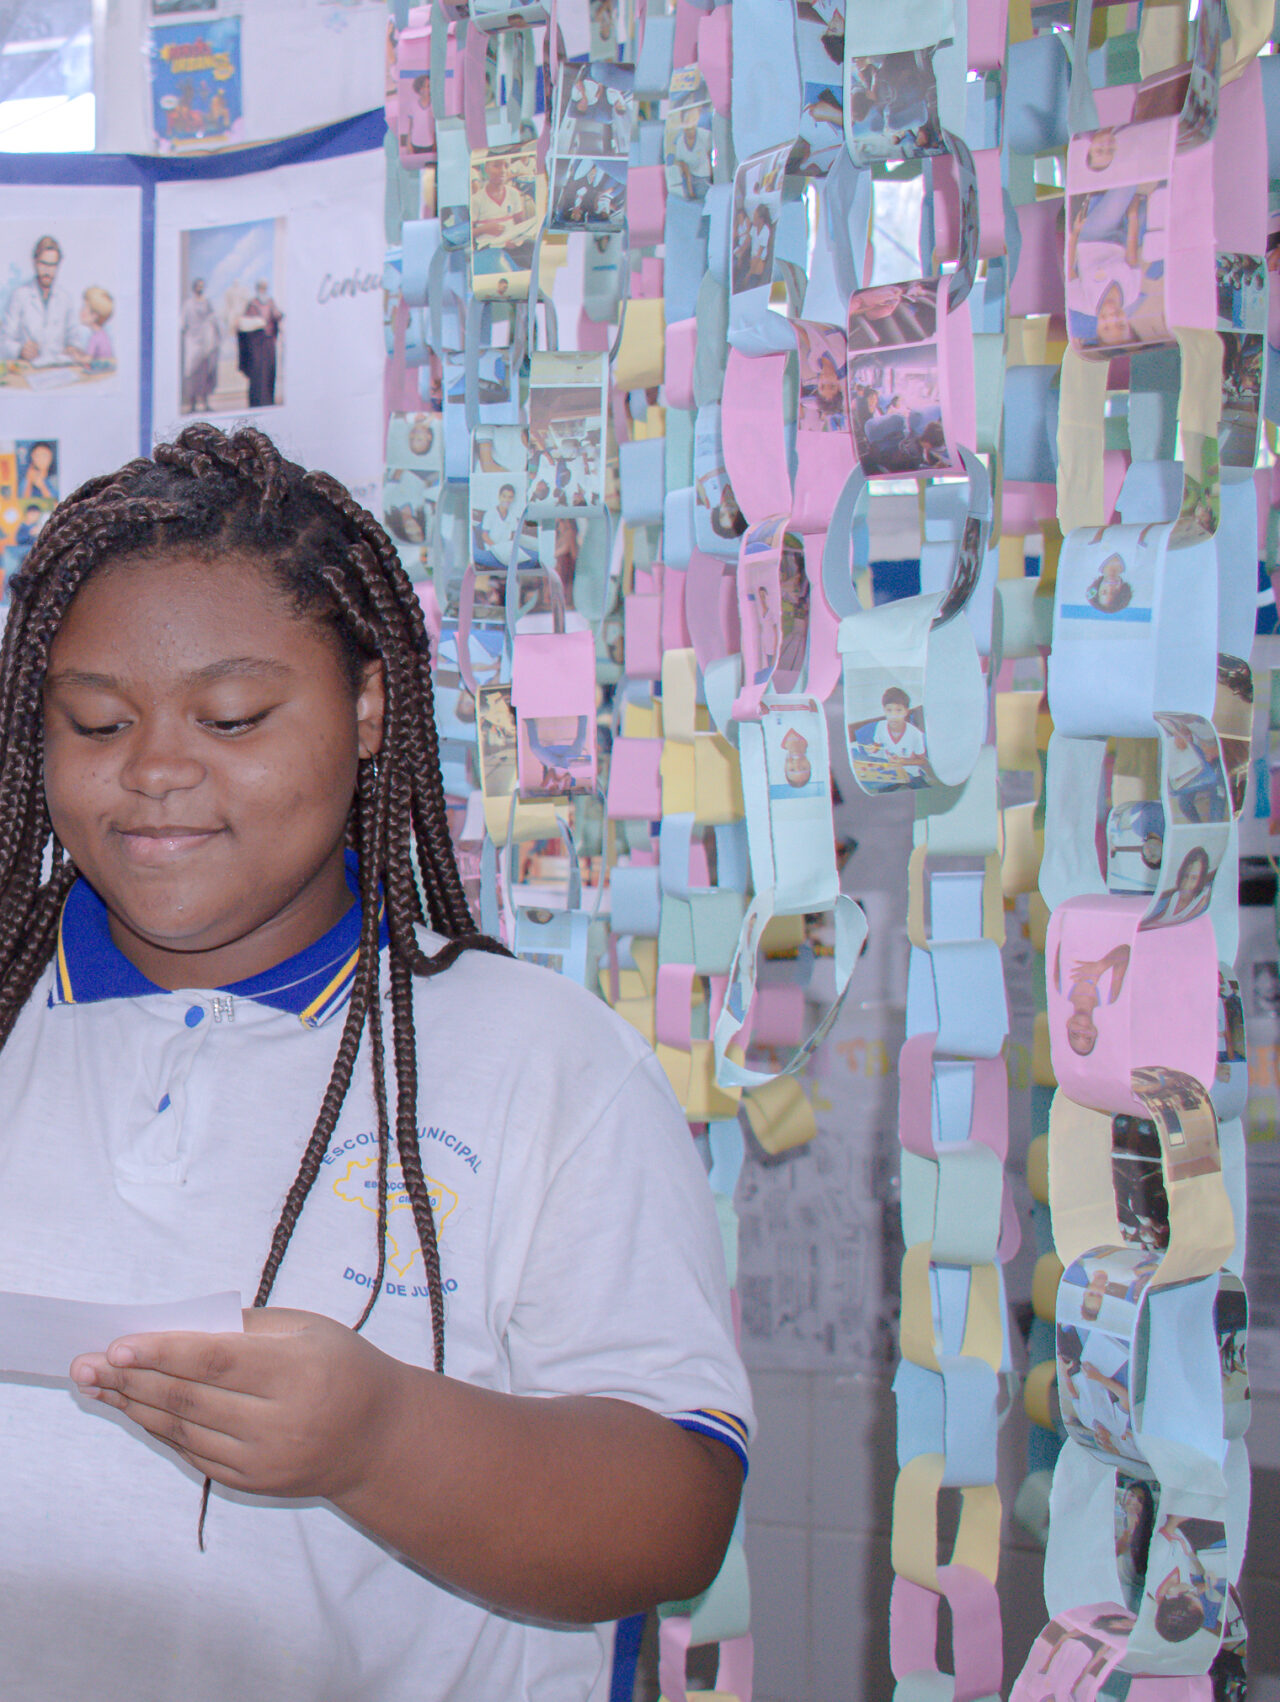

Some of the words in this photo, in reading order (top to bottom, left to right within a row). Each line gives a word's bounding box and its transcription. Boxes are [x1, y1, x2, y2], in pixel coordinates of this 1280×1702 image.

[414, 1126, 482, 1174] UNICIPAL
[386, 1283, 407, 1296] DE
[411, 1278, 458, 1297] JUO
